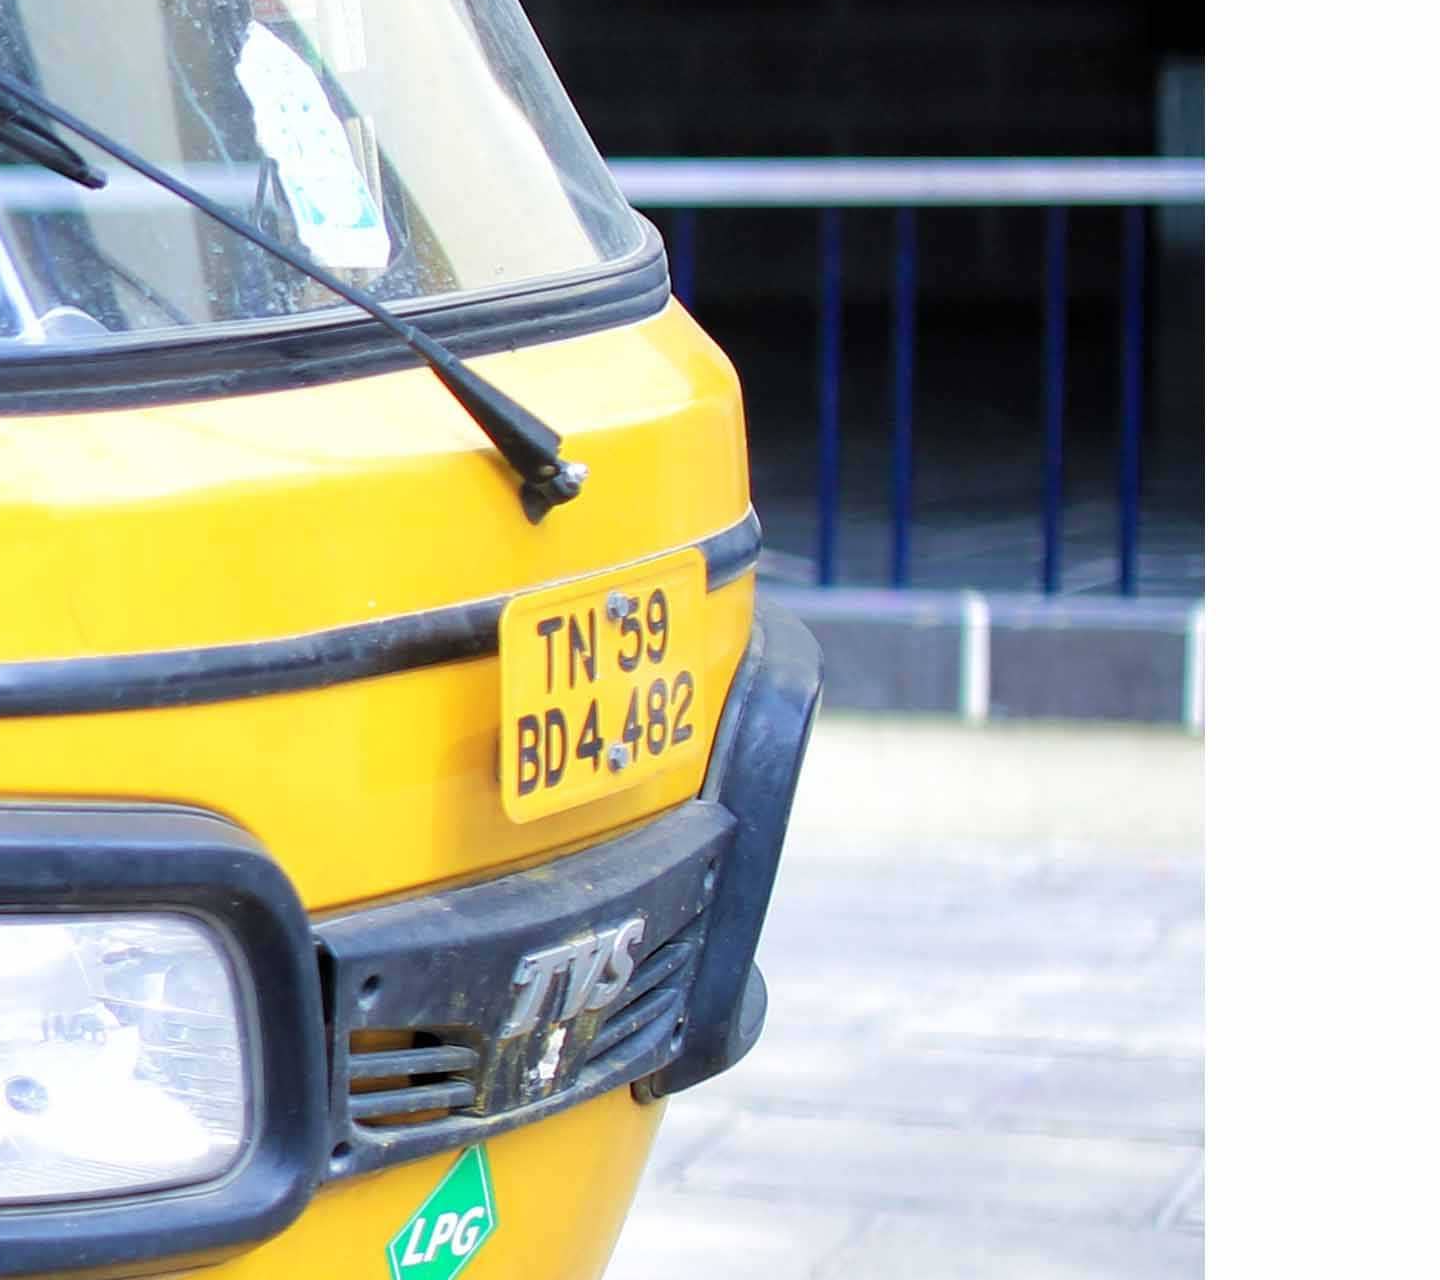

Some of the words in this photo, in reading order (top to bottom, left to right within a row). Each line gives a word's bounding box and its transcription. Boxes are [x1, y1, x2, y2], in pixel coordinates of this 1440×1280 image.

[537, 607, 597, 694] TN
[616, 588, 669, 672] 59
[499, 918, 646, 1039] TVS
[399, 1205, 486, 1268] LPG
